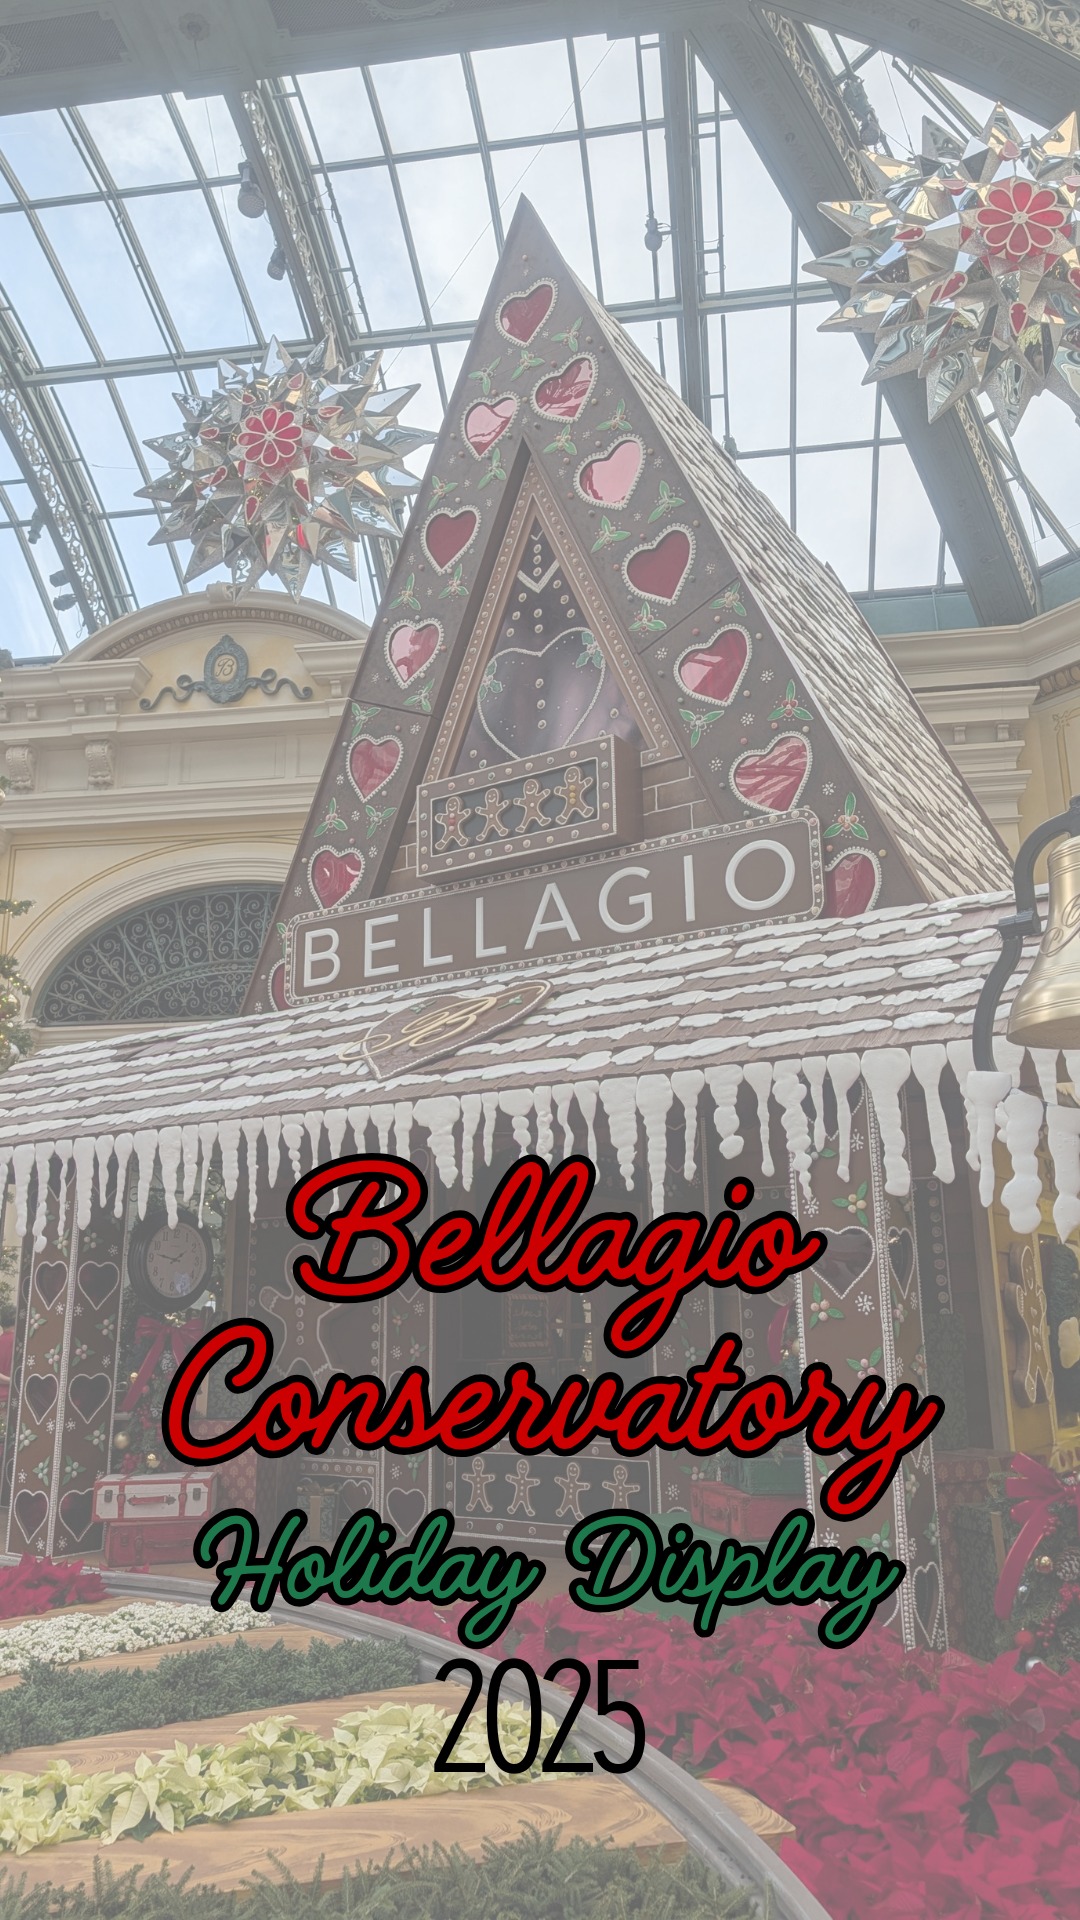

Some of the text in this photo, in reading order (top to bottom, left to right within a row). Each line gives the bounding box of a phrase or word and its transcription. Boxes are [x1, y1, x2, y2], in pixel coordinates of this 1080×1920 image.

[303, 839, 796, 988] BELLAGIO
[163, 1231, 169, 1241] 11
[154, 1240, 161, 1251] 10
[148, 1253, 154, 1263] 9
[152, 1266, 158, 1276] 8
[169, 1281, 175, 1292] 6
